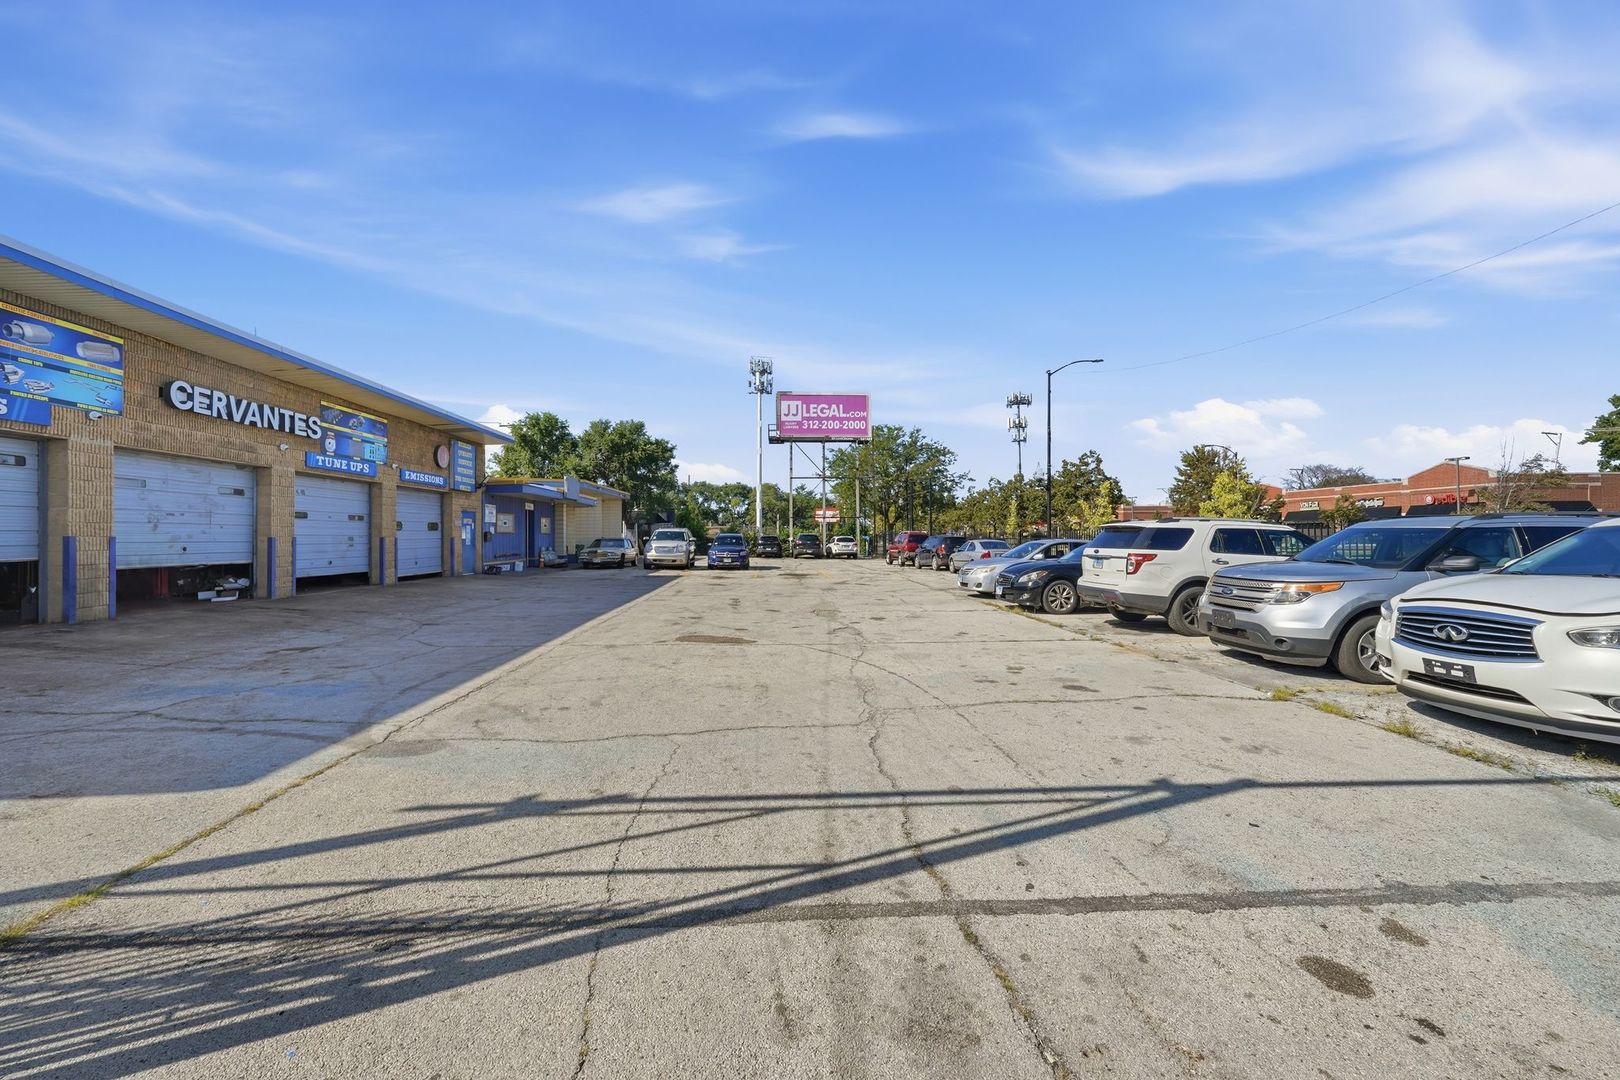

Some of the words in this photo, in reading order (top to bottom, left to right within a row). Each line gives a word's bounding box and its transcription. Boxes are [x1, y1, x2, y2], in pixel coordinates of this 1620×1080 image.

[169, 380, 322, 440] CERVANTES
[802, 420, 866, 429] 312-200-2000
[316, 455, 348, 470] TUNE
[350, 461, 370, 473] UPS
[405, 470, 444, 486] EMISSIONS
